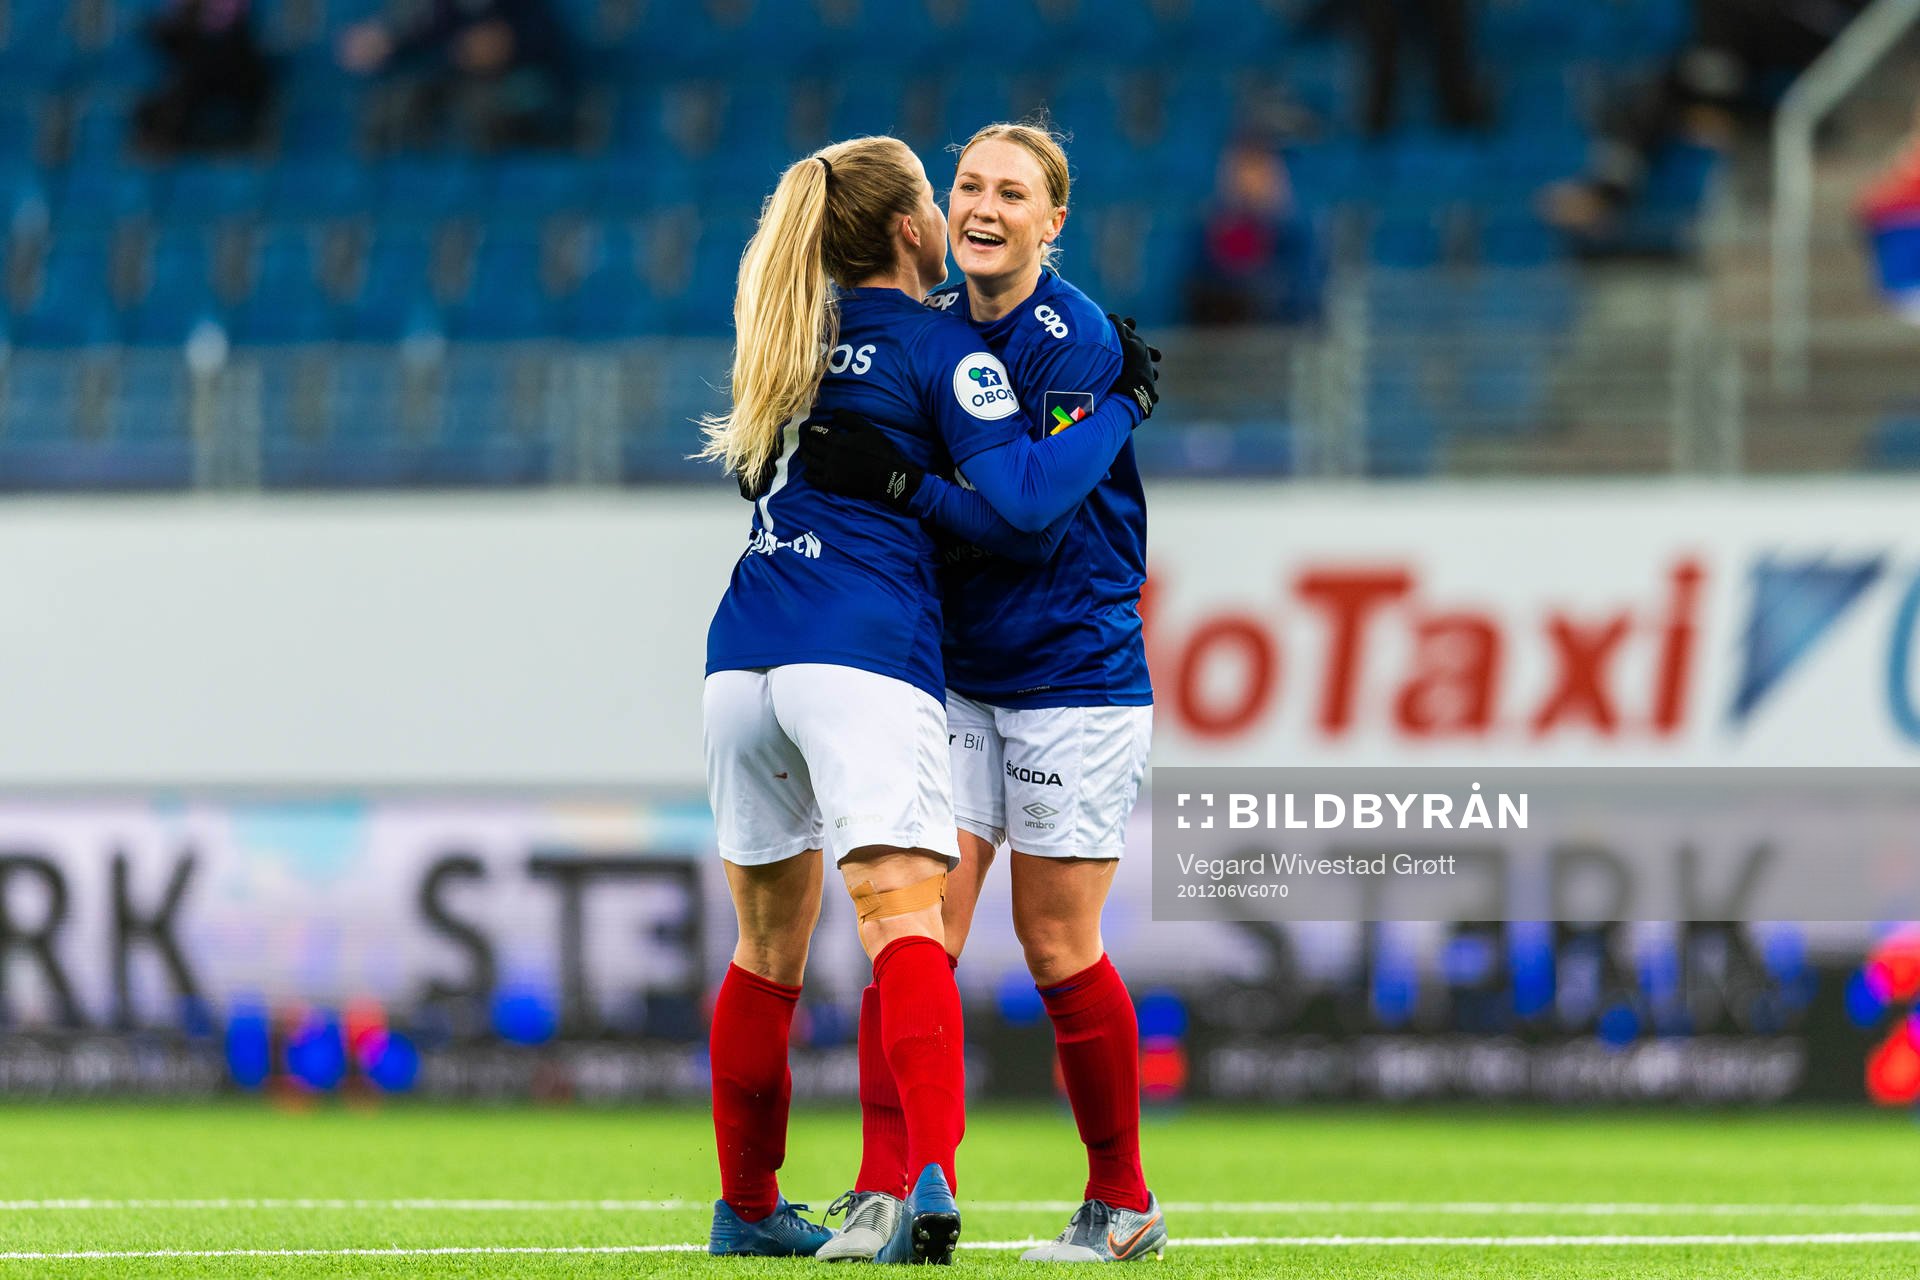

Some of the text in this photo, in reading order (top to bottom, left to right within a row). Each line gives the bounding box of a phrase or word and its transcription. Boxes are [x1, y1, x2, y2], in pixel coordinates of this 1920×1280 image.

[820, 343, 877, 375] OS
[1143, 560, 1706, 742] oTaxi
[948, 733, 985, 751] r Bil
[1024, 819, 1056, 830] umbro
